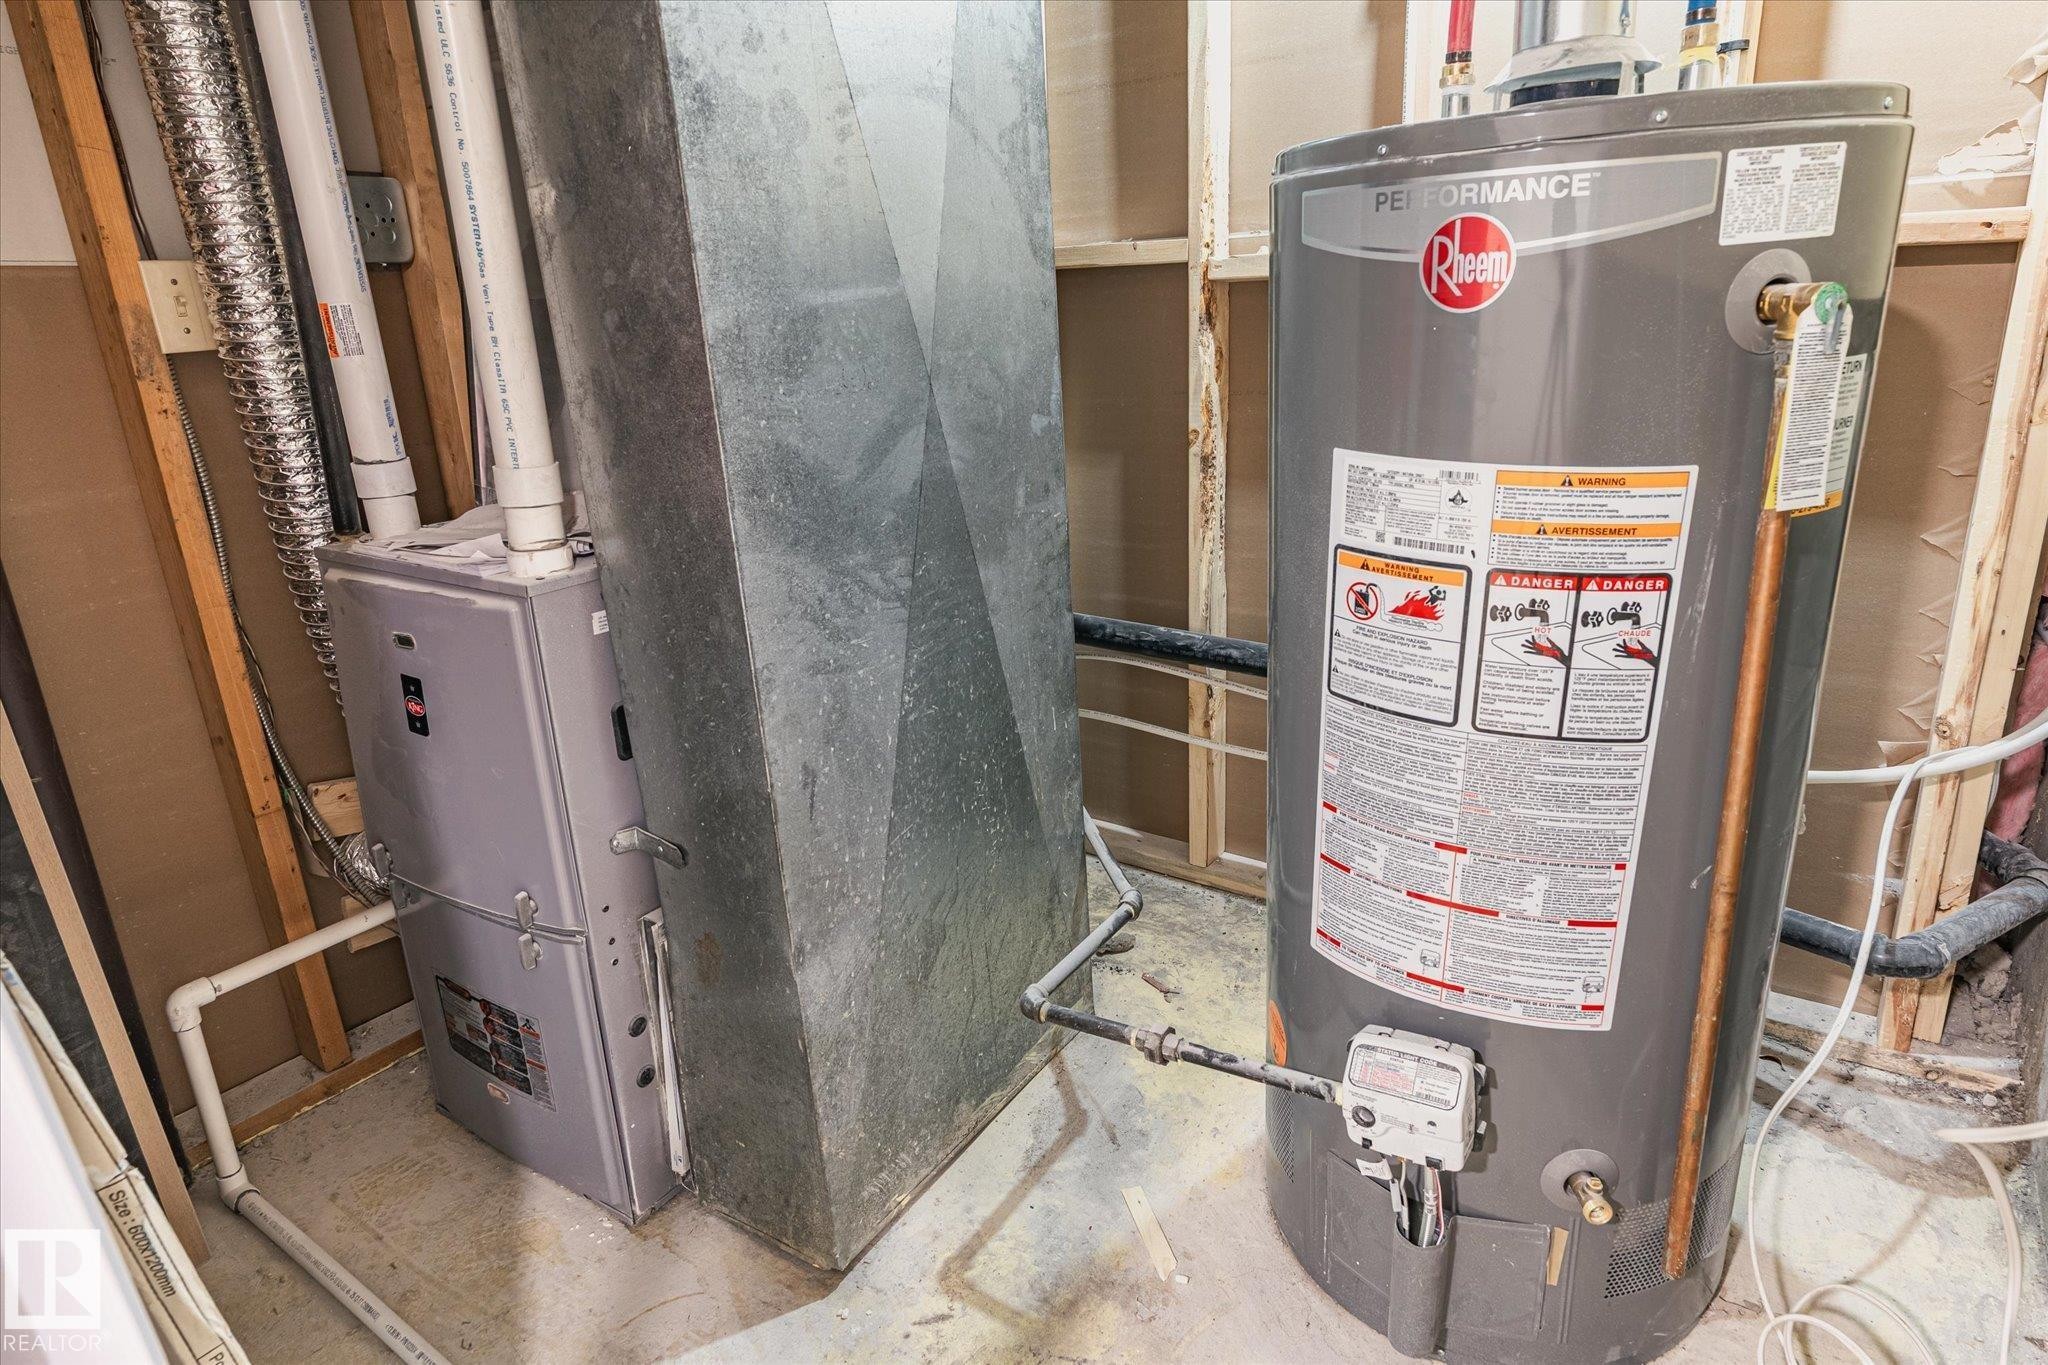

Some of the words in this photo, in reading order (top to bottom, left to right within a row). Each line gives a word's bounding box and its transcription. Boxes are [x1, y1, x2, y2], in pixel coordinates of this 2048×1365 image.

[439, 38, 450, 58] ULC
[443, 62, 455, 88] S636
[448, 91, 463, 133] Control
[456, 138, 467, 156] No.
[460, 161, 475, 201] 5007864
[1430, 219, 1509, 297] Rheem
[481, 283, 492, 305] Vent
[484, 310, 497, 332] Type
[503, 416, 514, 433] PVC
[1578, 478, 1626, 486] WARNING
[1552, 527, 1638, 536] AVERTISSEMENT
[1372, 566, 1434, 582] AVERTISSEMENT
[1384, 562, 1420, 573] WARNING
[1511, 577, 1573, 589] DANGER
[1603, 579, 1665, 590] DANGER
[109, 1189, 131, 1218] Size
